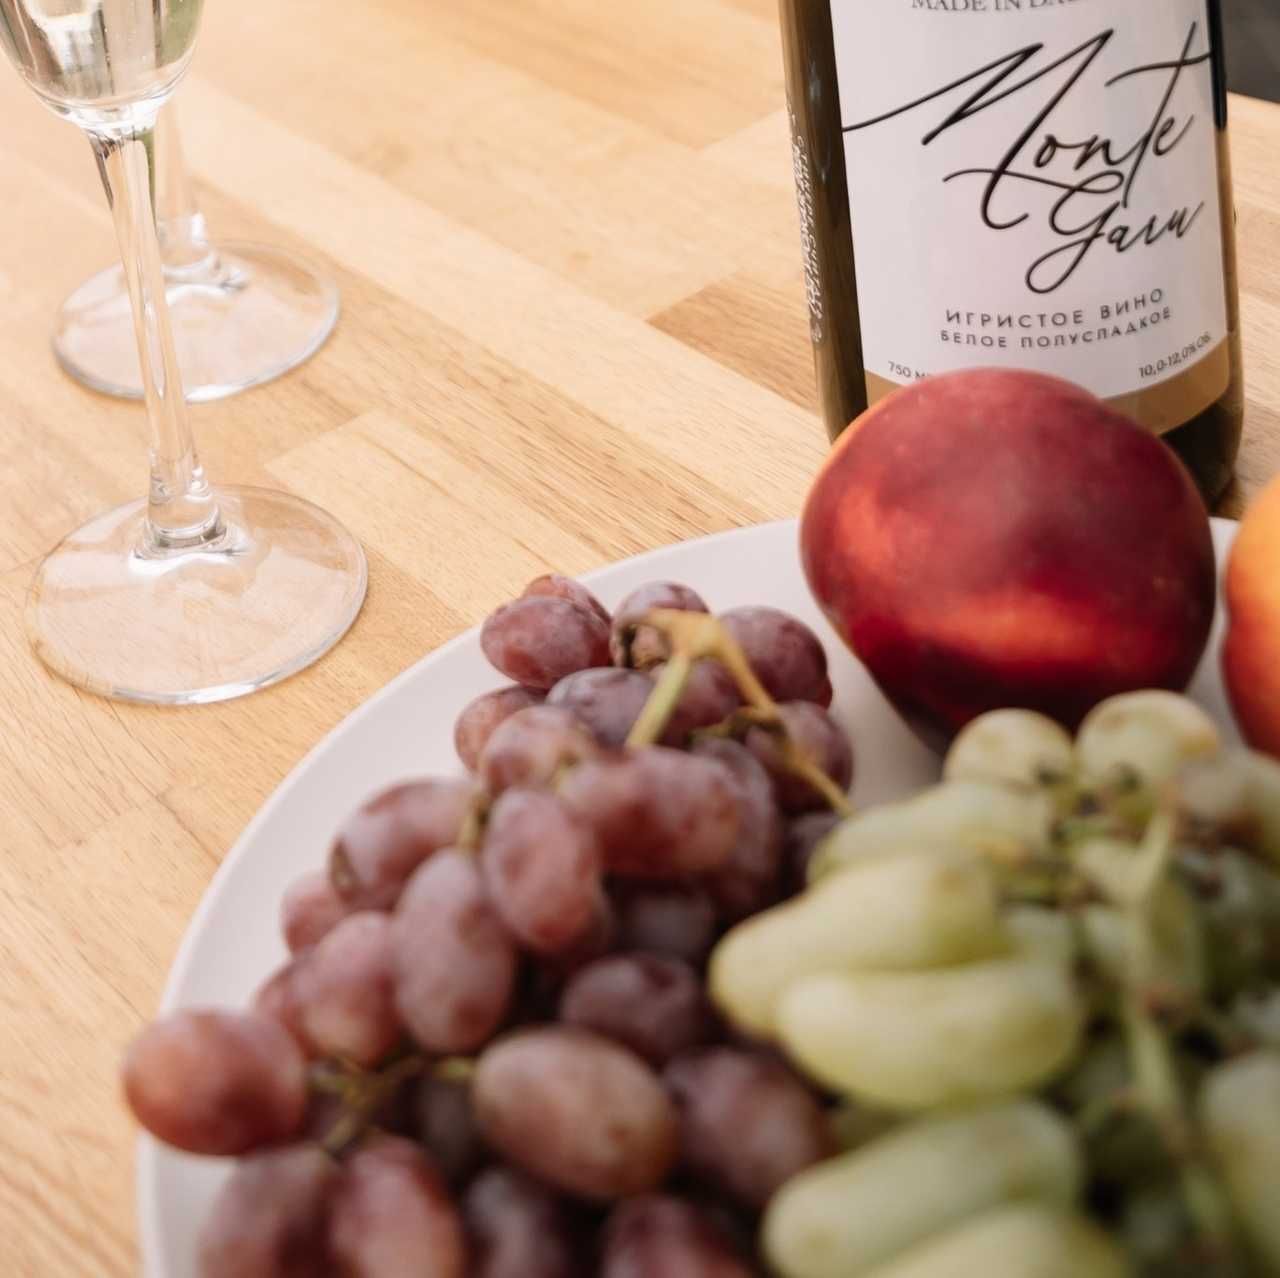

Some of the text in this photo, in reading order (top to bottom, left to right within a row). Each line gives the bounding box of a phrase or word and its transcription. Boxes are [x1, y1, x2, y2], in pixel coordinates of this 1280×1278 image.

[842, 21, 1213, 230] Monte
[941, 306, 1170, 348] БЕЛОЕ ПОЛУСЛАДКОЕ
[946, 288, 1163, 328] ИГРИСТОЕ ВИНО
[887, 360, 911, 378] 750
